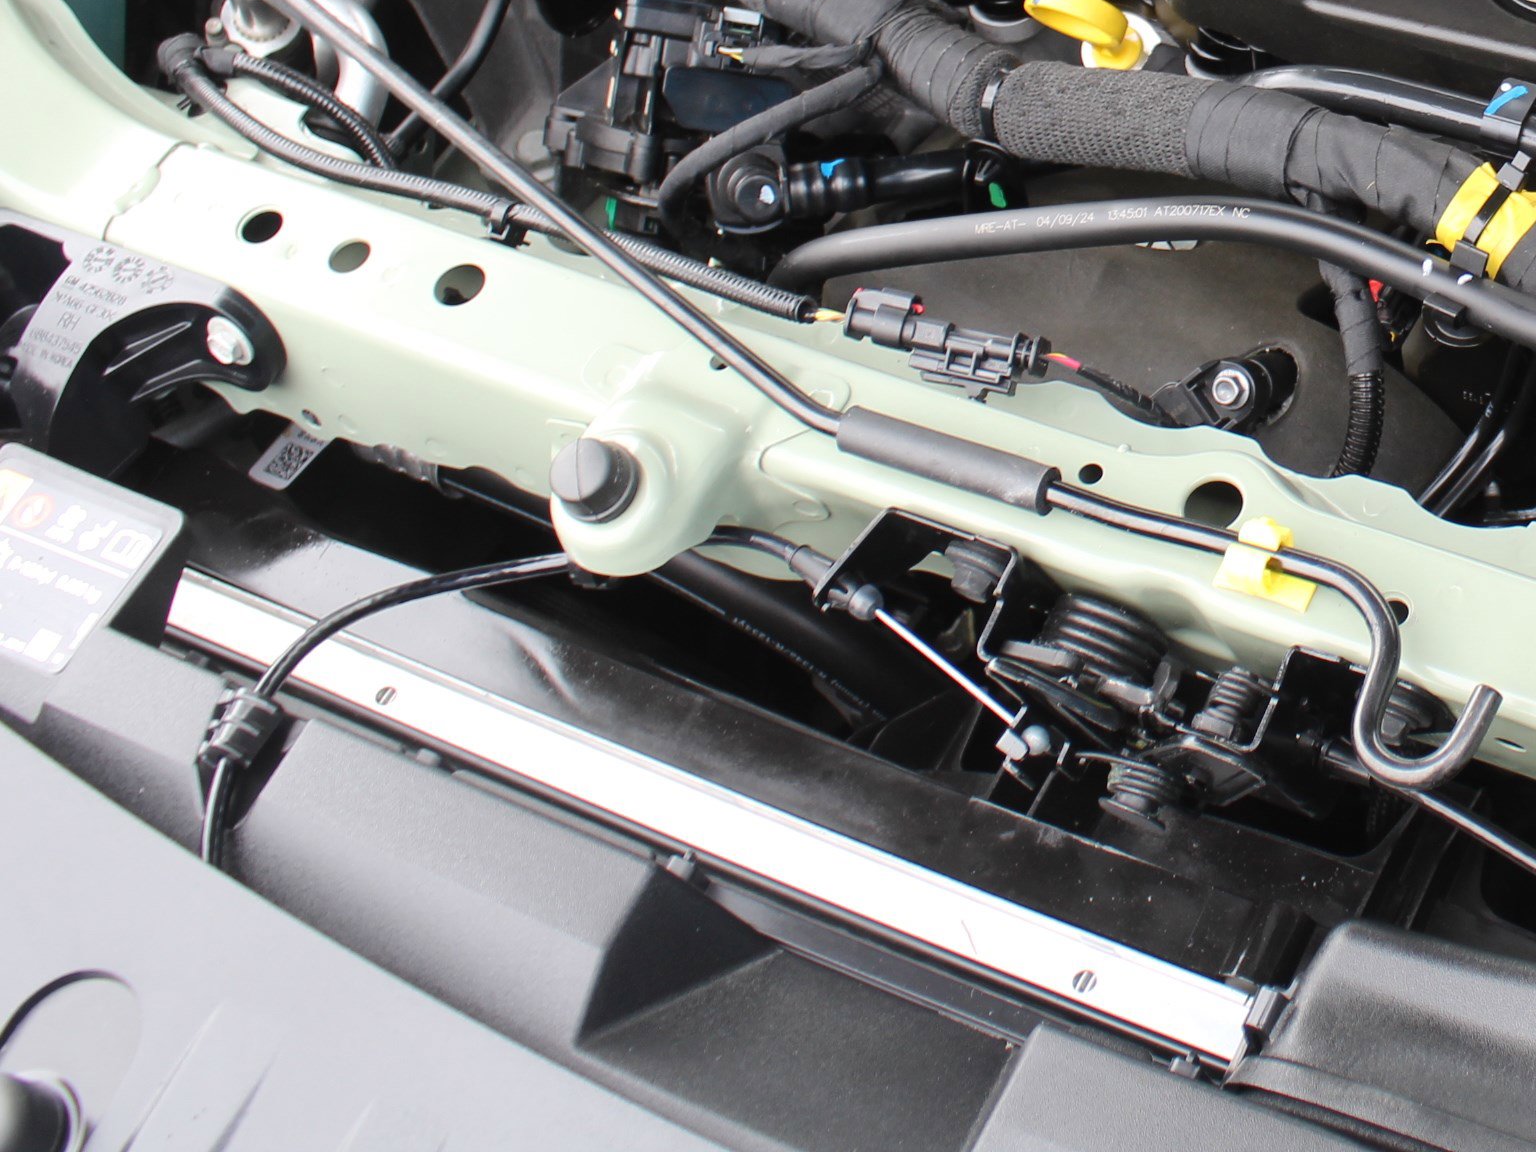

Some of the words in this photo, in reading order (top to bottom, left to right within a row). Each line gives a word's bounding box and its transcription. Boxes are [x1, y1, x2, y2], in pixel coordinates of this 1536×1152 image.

[1036, 211, 1095, 230] 04/09/24
[1154, 204, 1226, 219] AT200717EX
[1232, 206, 1251, 220] NC
[57, 310, 81, 331] RH
